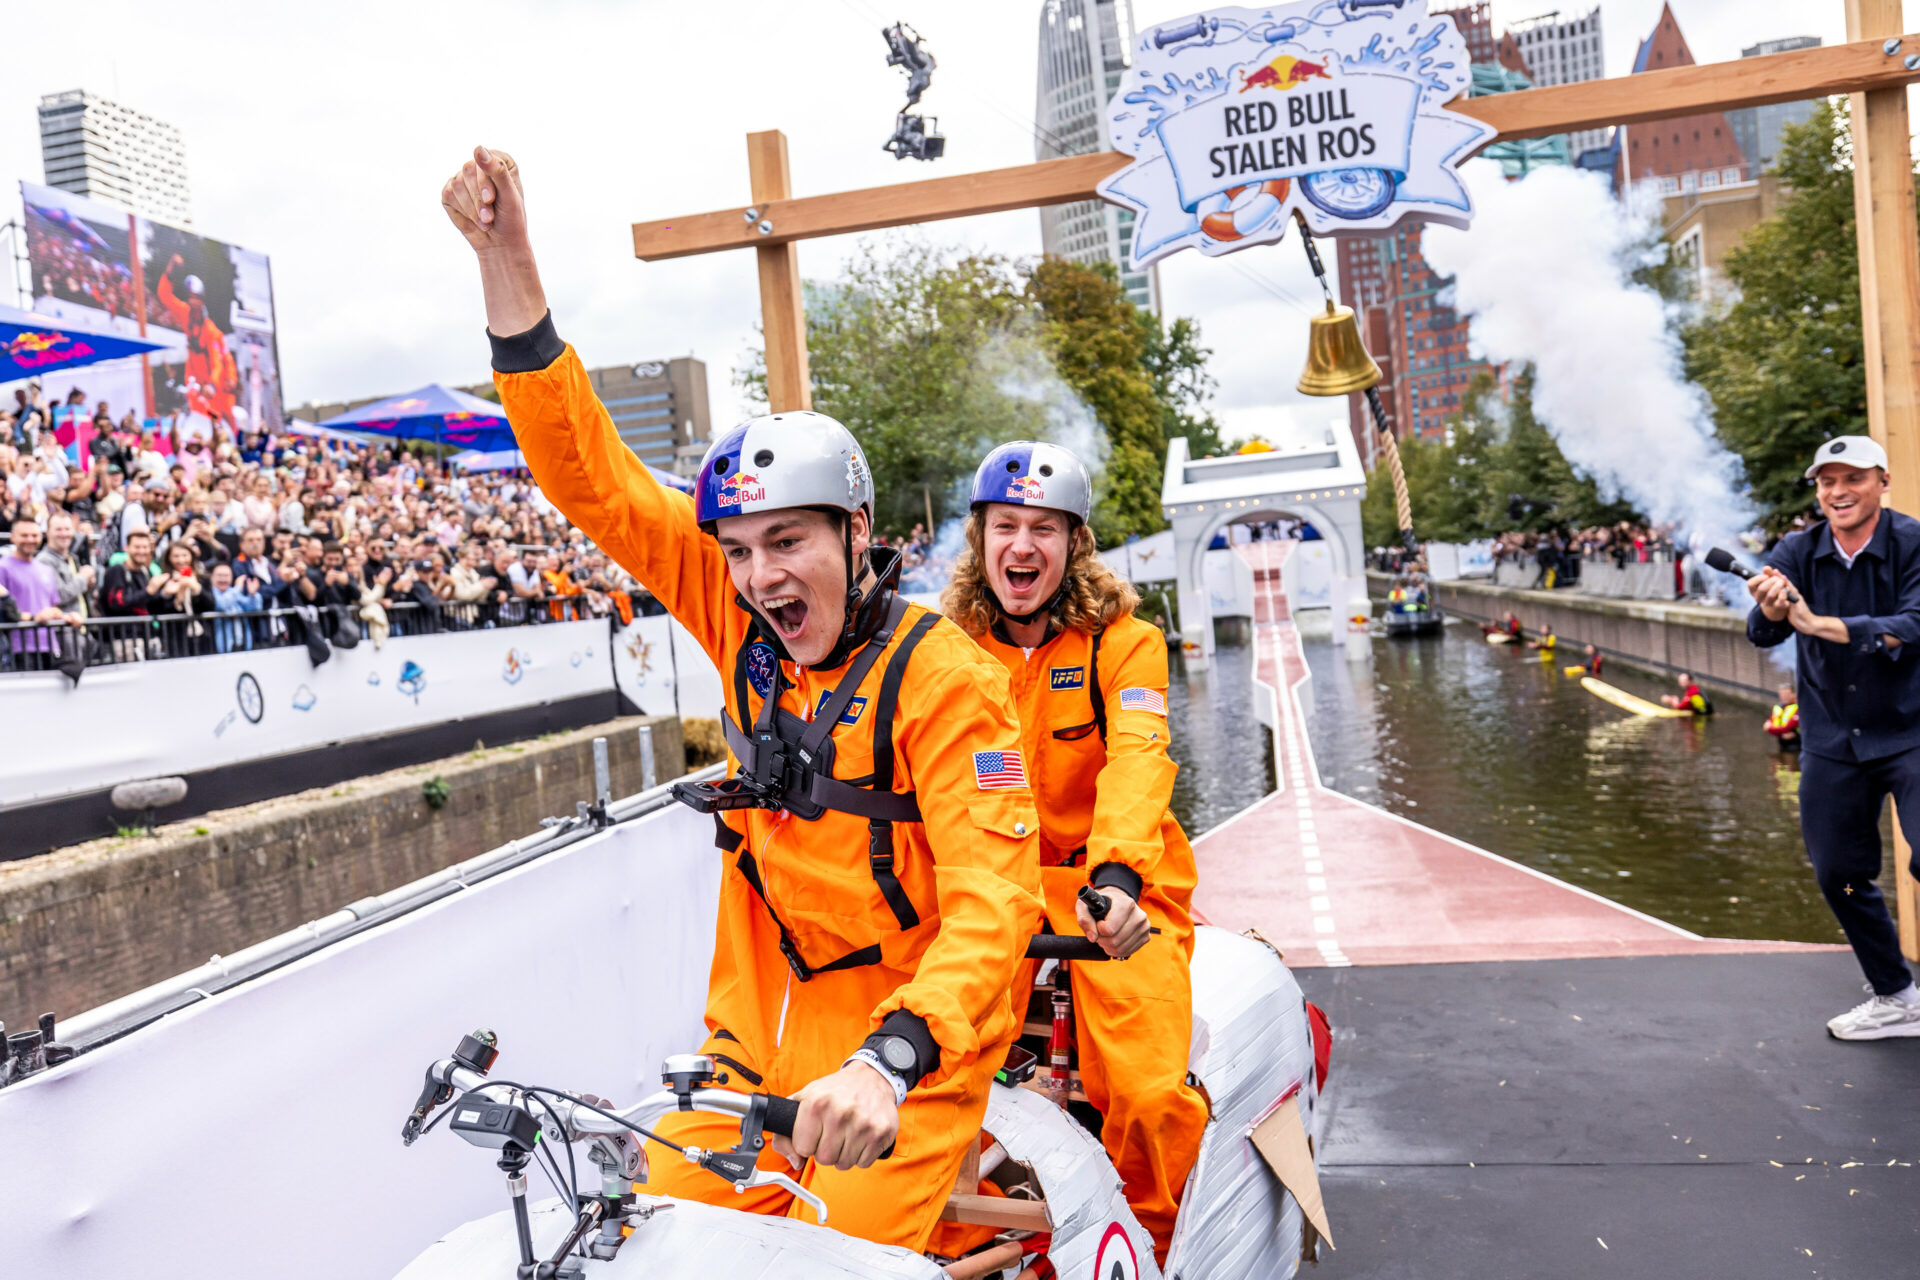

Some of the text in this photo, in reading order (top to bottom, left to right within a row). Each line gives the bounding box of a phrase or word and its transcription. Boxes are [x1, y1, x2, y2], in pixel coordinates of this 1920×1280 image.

[1224, 88, 1356, 138] RED BULL
[1209, 123, 1377, 179] STALEN ROS
[718, 487, 766, 507] Red Bull
[1006, 486, 1045, 500] Red Bull
